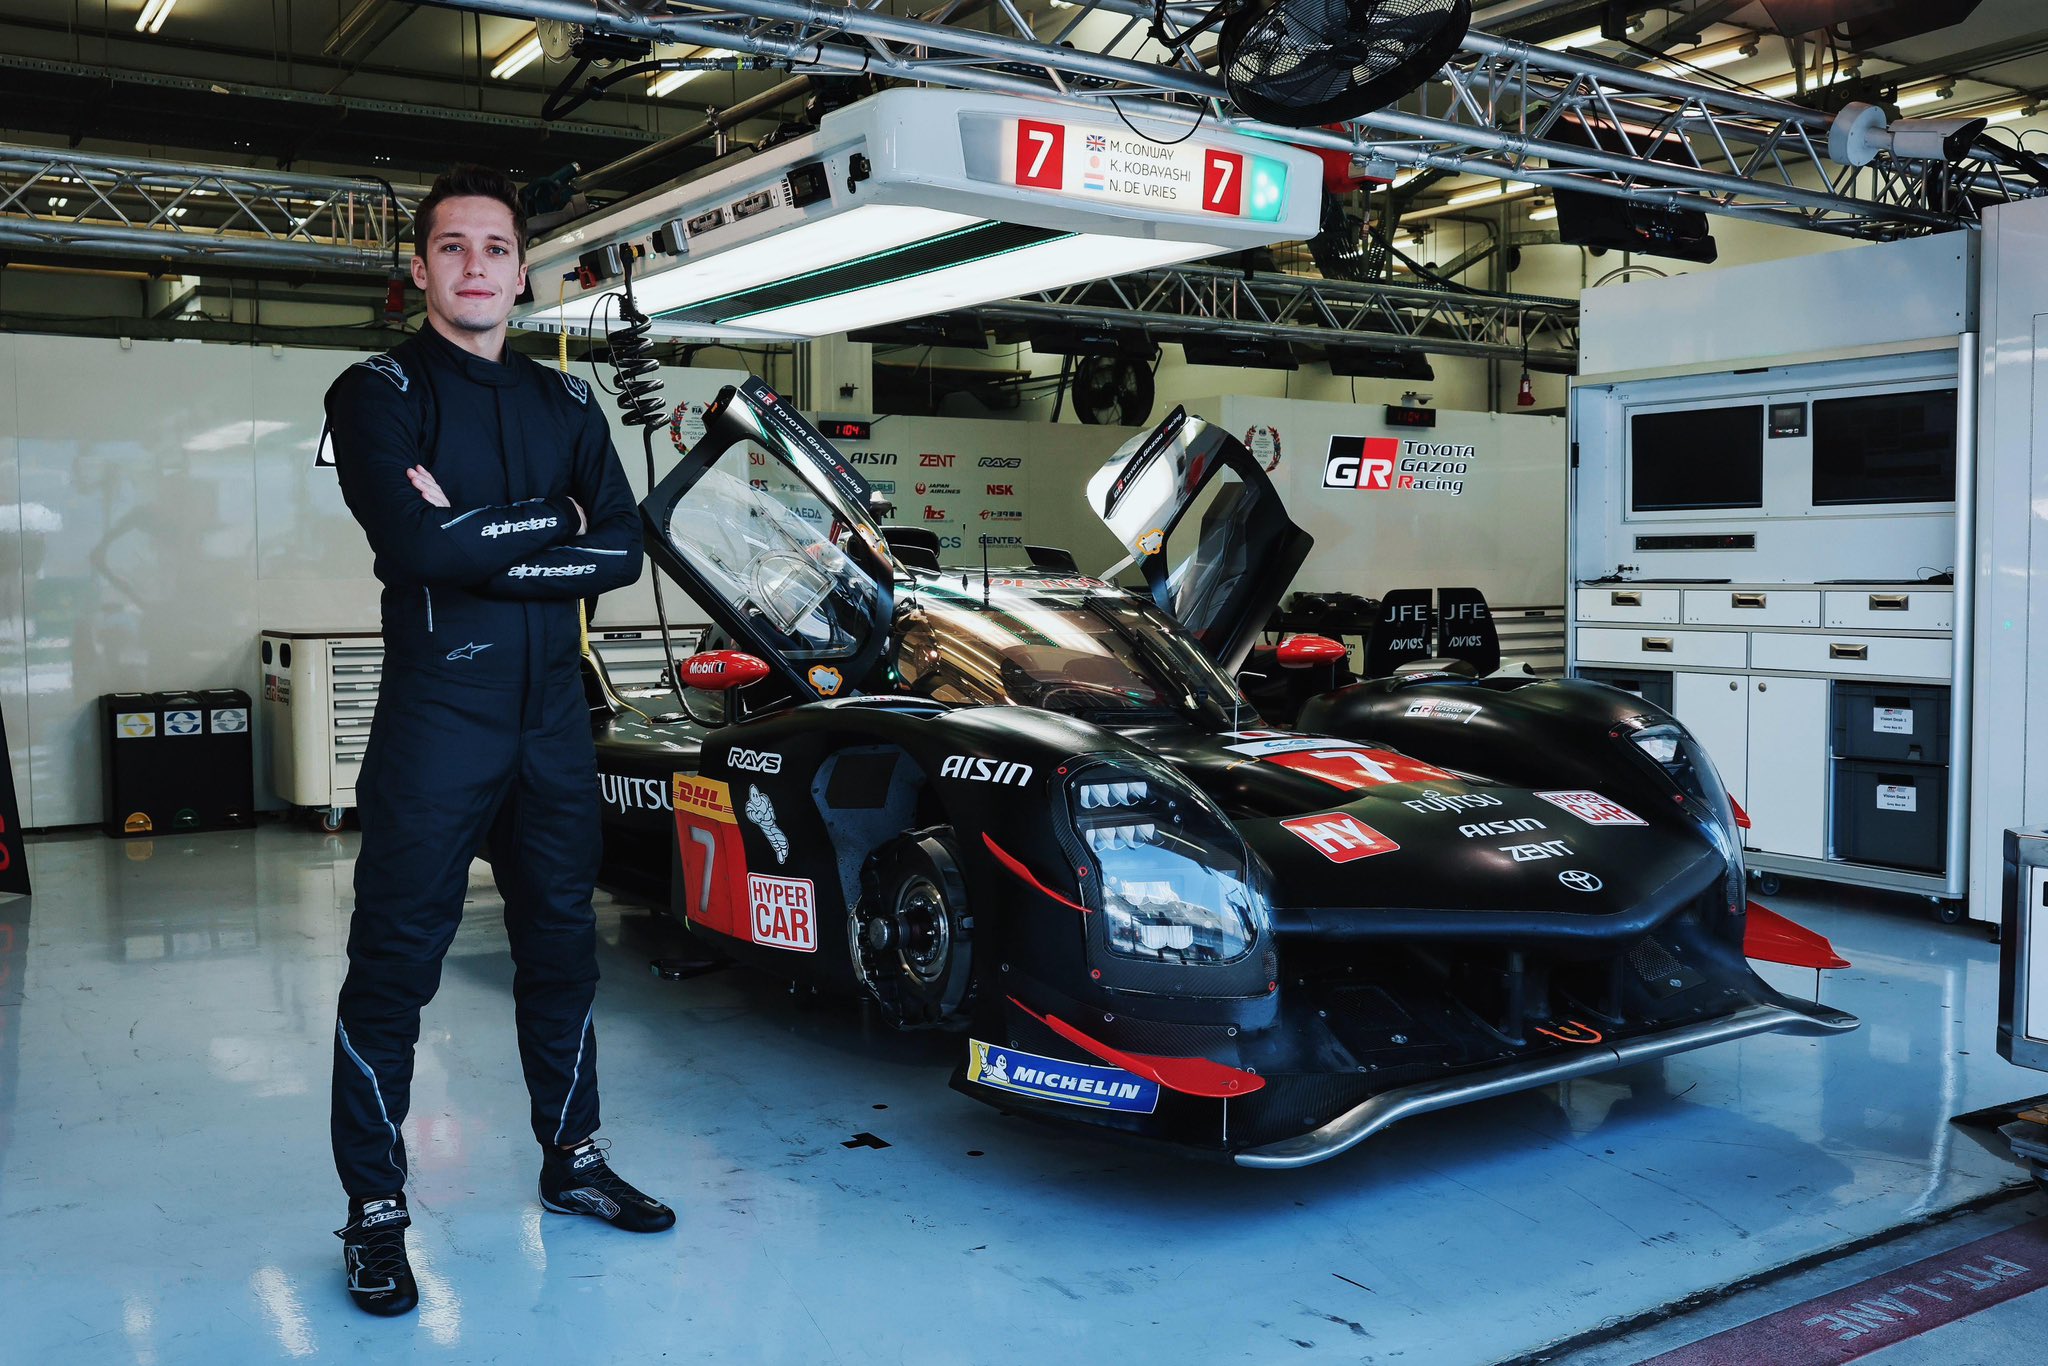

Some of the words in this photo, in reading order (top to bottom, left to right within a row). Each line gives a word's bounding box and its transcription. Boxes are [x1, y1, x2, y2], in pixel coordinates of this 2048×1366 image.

[1028, 130, 1054, 178] 7
[1110, 140, 1122, 153] M.
[1125, 142, 1174, 160] CONWAY
[1110, 160, 1121, 172] K.
[1124, 162, 1191, 182] KOBAYASHI
[1212, 159, 1234, 204] 7
[1110, 179, 1121, 192] N.
[1124, 180, 1140, 194] DE
[1143, 184, 1176, 200] VRIES
[756, 390, 774, 406] GR
[774, 404, 807, 437] TOYOTA
[806, 436, 836, 466] GAZOO
[835, 465, 862, 494] Racing
[1123, 456, 1144, 483] TOYOTA
[1143, 434, 1164, 458] GAZOO
[1164, 413, 1182, 435] Racing
[1404, 440, 1475, 458] TOYOTA
[850, 453, 898, 465] AISIN
[920, 454, 956, 467] ZENT
[978, 457, 1022, 468] RAYS
[1400, 458, 1467, 474] GAZOO
[1326, 456, 1392, 488] GR
[986, 484, 1014, 495] NSK
[1398, 476, 1464, 496] Racing
[481, 516, 558, 538] alpinestars
[508, 562, 596, 580] alpinestars
[1385, 605, 1427, 622] JFE
[1444, 604, 1486, 620] JFE
[690, 662, 715, 674] Mobil
[1464, 704, 1482, 724] 7
[728, 746, 782, 774] RAYS
[940, 755, 1034, 787] AISIN
[1309, 751, 1396, 782] 7
[598, 773, 674, 814] UJITSU
[678, 781, 723, 812] DHL
[1401, 790, 1503, 814] FUJITSU
[1545, 794, 1608, 804] HYPER
[1567, 804, 1638, 820] CAR
[1310, 817, 1377, 854] HY
[1458, 818, 1547, 838] AISIN
[1498, 840, 1574, 862] ZENT
[690, 826, 715, 913] 7
[752, 880, 808, 908] HYPER
[756, 904, 810, 943] CAR
[1012, 1065, 1141, 1100] MICHELIN
